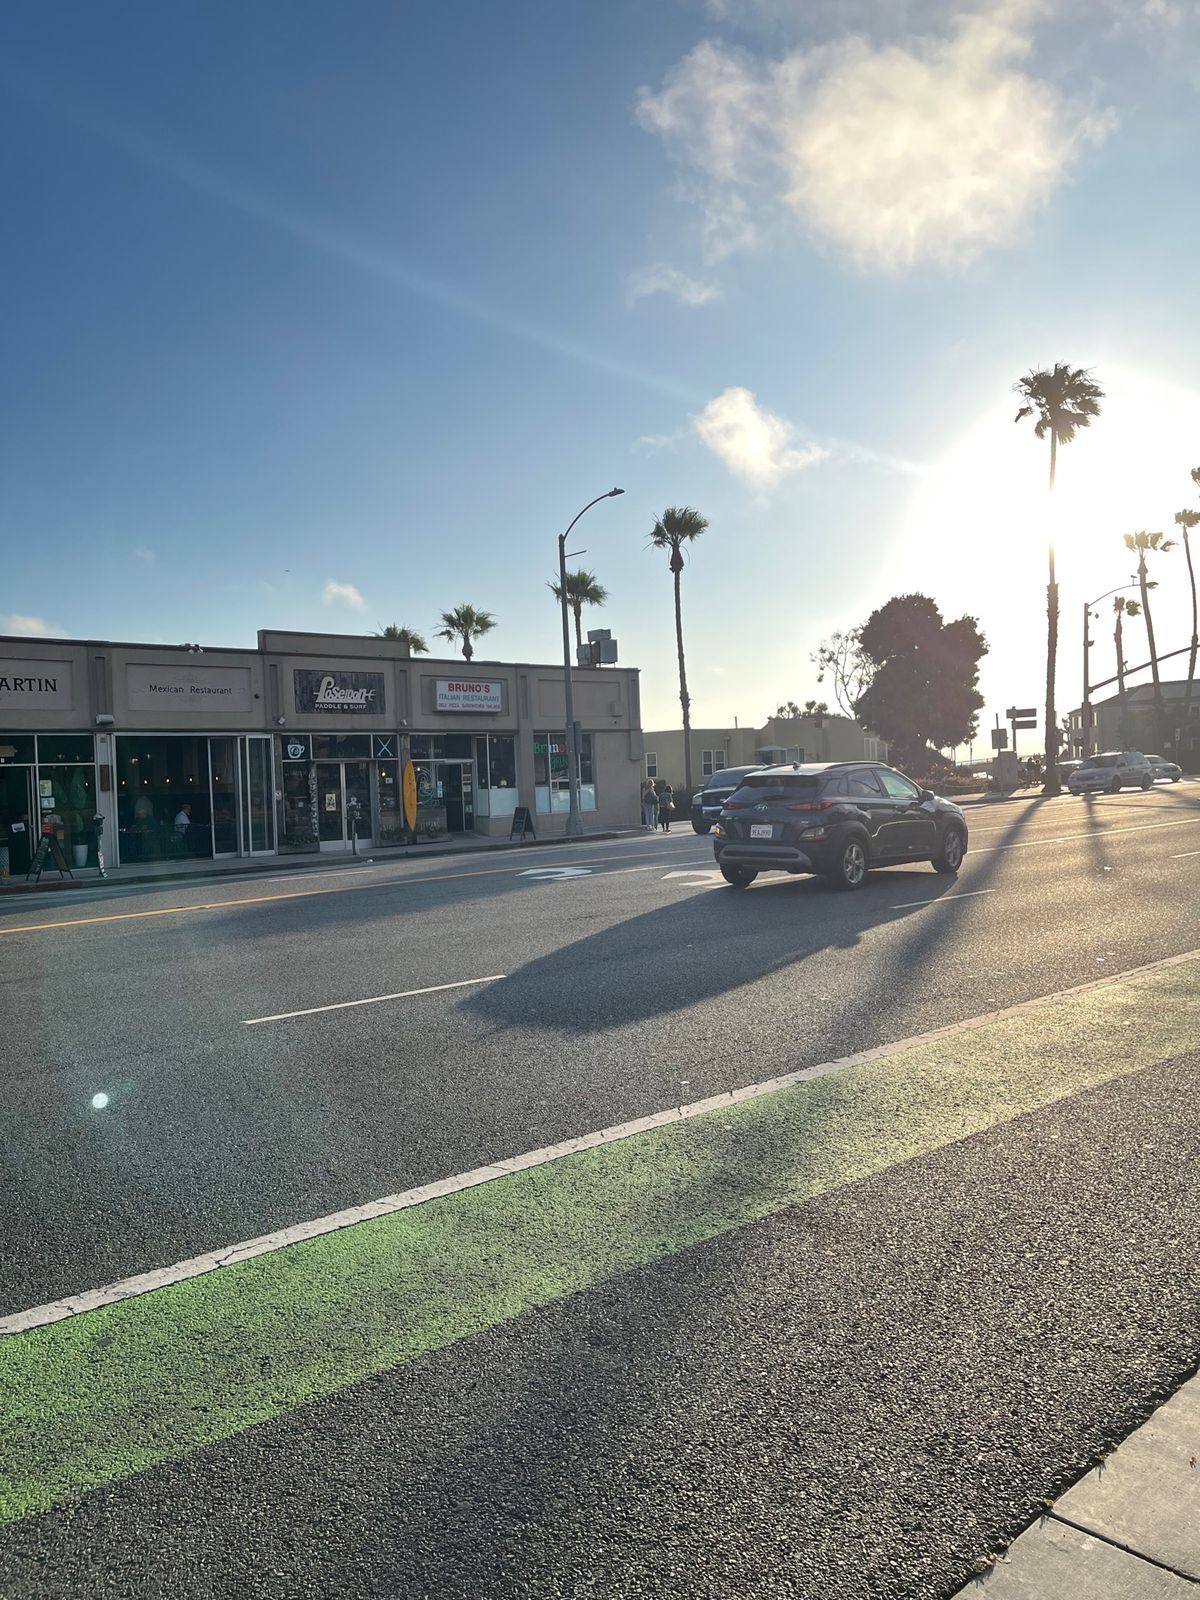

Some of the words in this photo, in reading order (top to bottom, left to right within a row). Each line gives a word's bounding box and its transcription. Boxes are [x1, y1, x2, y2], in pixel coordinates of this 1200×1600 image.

[149, 685, 184, 694] Mexican
[190, 686, 232, 695] Restaurant
[447, 682, 490, 693] BRUNO'S
[438, 693, 460, 701] ITALIAN
[463, 694, 499, 702] RESTAURANT
